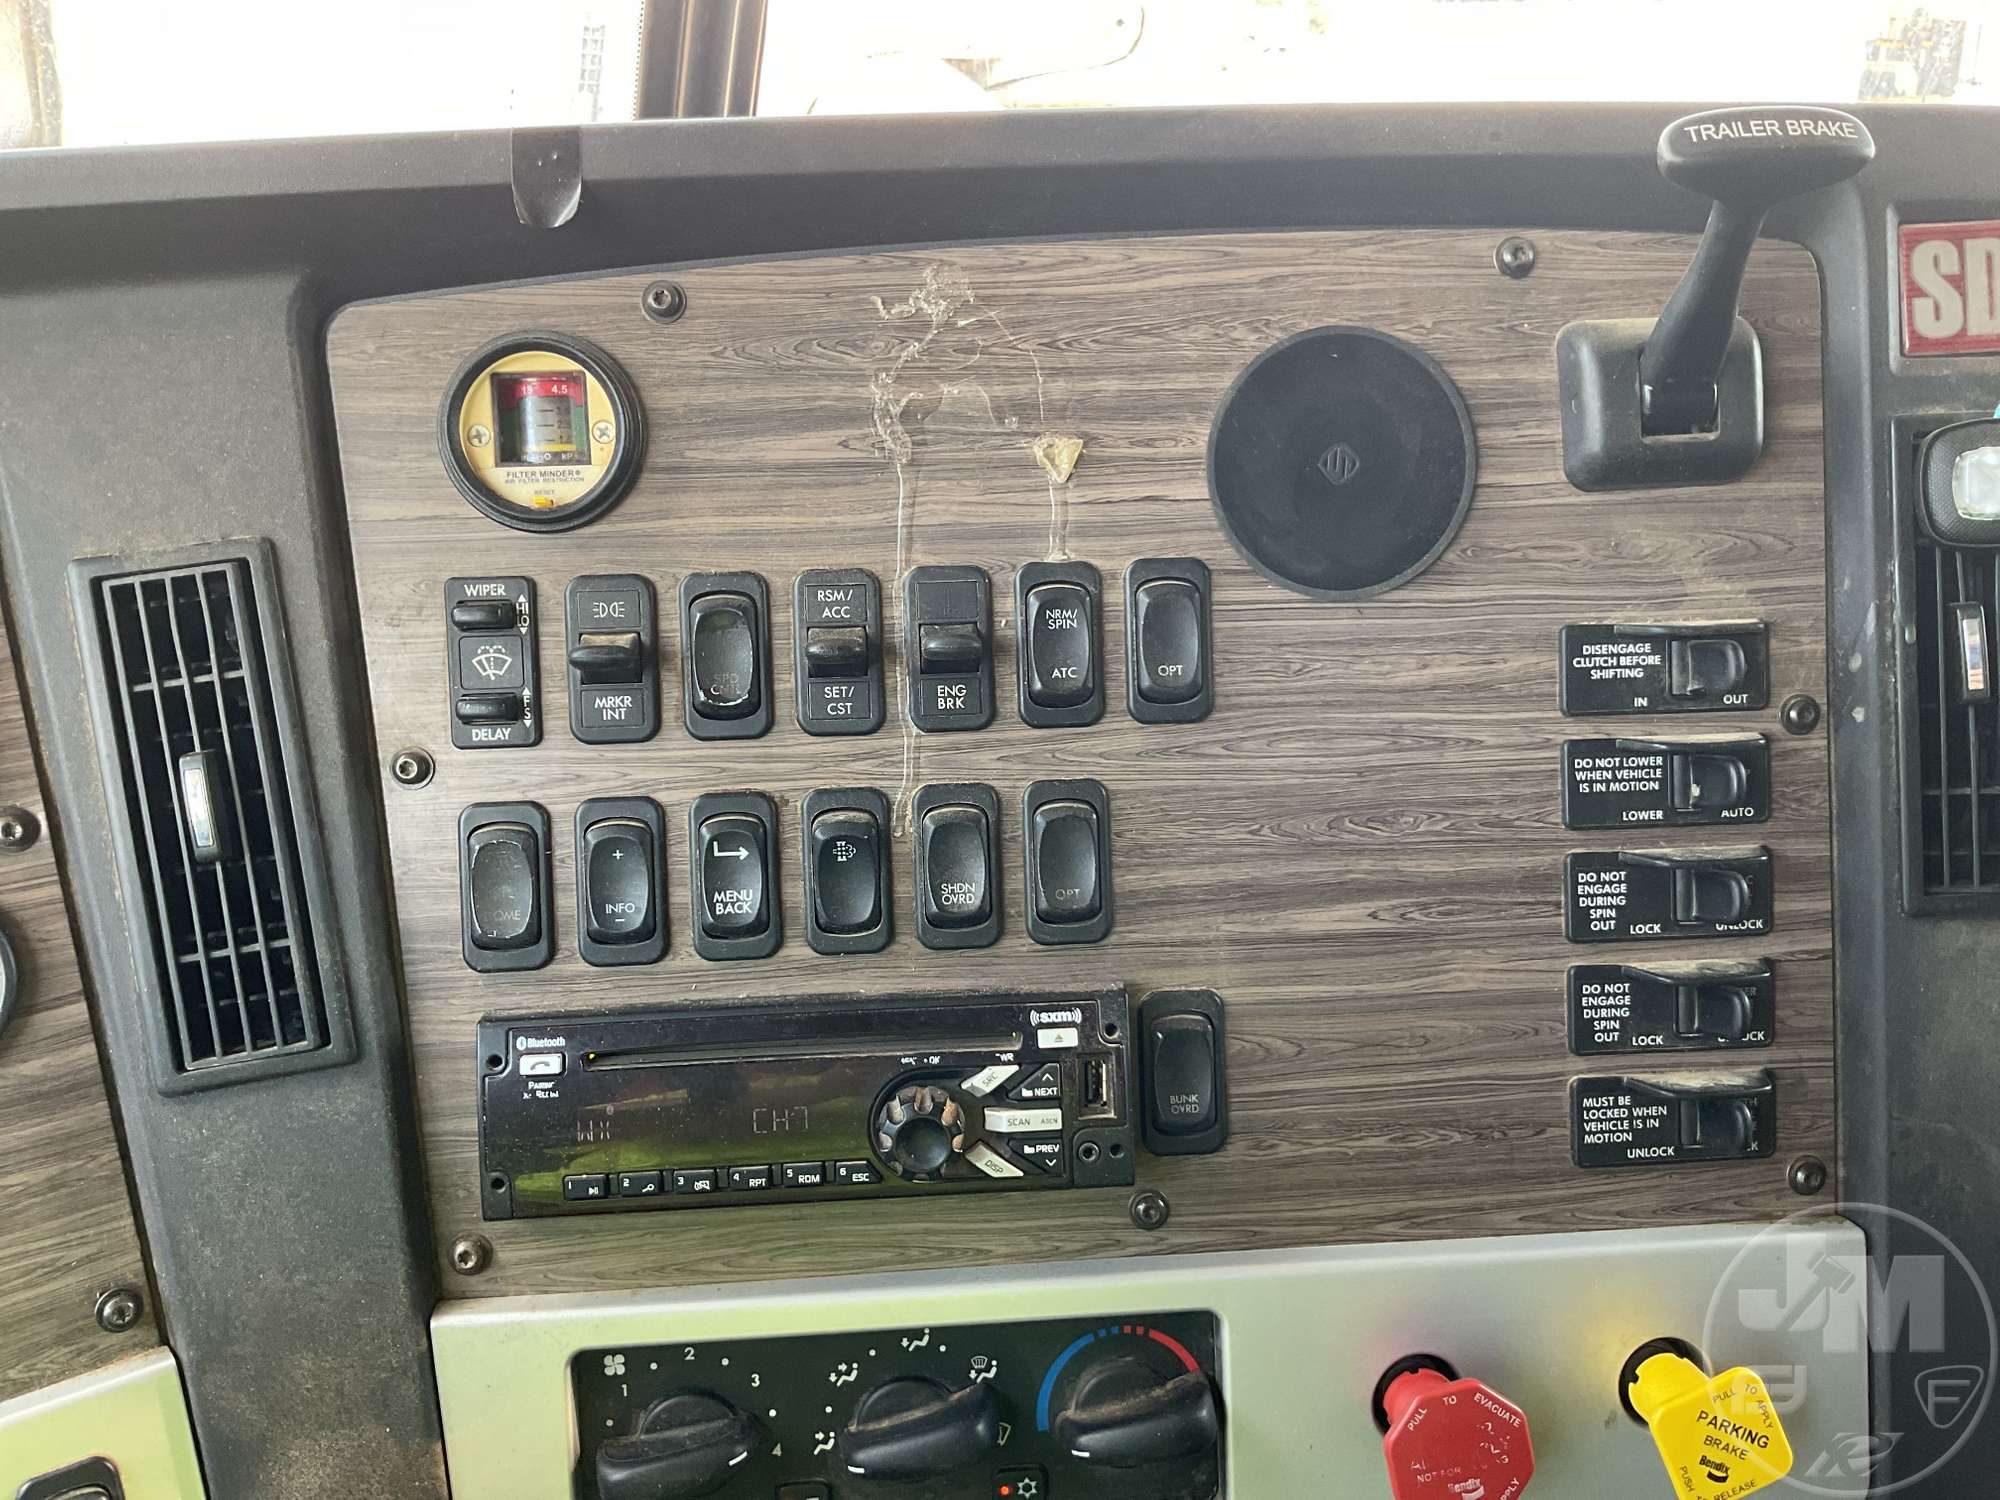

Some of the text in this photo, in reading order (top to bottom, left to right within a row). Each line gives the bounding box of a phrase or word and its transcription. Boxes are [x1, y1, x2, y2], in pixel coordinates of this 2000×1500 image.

[1684, 120, 1858, 142] TRAILER BRAKE
[551, 384, 568, 394] 4.5
[506, 471, 536, 479] FILTER
[464, 584, 506, 596] WIPER
[817, 589, 853, 602] RSM/
[516, 602, 528, 614] HI
[822, 606, 850, 618] ACC
[1046, 608, 1078, 620] NRM/
[516, 615, 530, 626] LO
[1048, 618, 1078, 630] SPIN
[1582, 643, 1652, 655] DISENGAGE
[1572, 656, 1662, 668] CLUTCH BEFORE
[1052, 668, 1078, 679] ATC
[1158, 665, 1183, 676] OPT
[1590, 668, 1644, 680] SHIFTING
[824, 686, 854, 698] SET/
[937, 684, 966, 697] ENG
[524, 695, 530, 706] F
[594, 696, 632, 708] MRKR
[938, 698, 965, 710] BRK
[1634, 697, 1648, 707] IN
[1723, 694, 1748, 704] OUT
[524, 708, 531, 720] S
[602, 708, 626, 720] INT
[827, 702, 852, 714] CST
[472, 728, 511, 742] DELAY
[1574, 756, 1663, 768] DO NOT LOWER
[1575, 768, 1662, 780] WHEN VEHICLE
[1579, 781, 1660, 793] IS IN MOTION
[1622, 810, 1664, 821] LOWER
[1720, 807, 1754, 818] AUTO
[1578, 871, 1626, 883] DO NOT
[940, 882, 976, 894] SHDN
[1055, 888, 1080, 900] OPT
[1577, 884, 1628, 895] ENGAGE
[713, 889, 753, 902] MENU
[941, 893, 975, 905] OVRD
[1579, 896, 1626, 907] DURING
[605, 902, 636, 914] INFO
[715, 902, 752, 915] BACK
[1590, 908, 1616, 919] SPIN
[1590, 920, 1616, 931] OUT
[1630, 924, 1662, 935] LOCK
[1582, 983, 1630, 994] DO NOT
[1582, 996, 1631, 1006] ENGAGE
[1584, 1008, 1630, 1019] DURING
[1593, 1020, 1620, 1030] SPIN
[528, 1036, 566, 1048] Bluetooth
[1594, 1032, 1620, 1042] OUT
[1632, 1035, 1664, 1046] LOCK
[982, 1072, 1000, 1088] SRC
[1034, 1087, 1058, 1096] NEXT
[1170, 1094, 1199, 1104] BUNK
[1582, 1096, 1632, 1108] MUST BE
[1170, 1104, 1200, 1114] OVRD
[1583, 1106, 1668, 1120] LOCKED WHEN
[1008, 1118, 1030, 1127] SCAN
[1584, 1118, 1660, 1132] VEHICLE IS IN
[1584, 1132, 1632, 1144] MOTION
[1036, 1144, 1060, 1153] PREV
[1626, 1146, 1675, 1158] UNLOCK
[984, 1159, 1004, 1174] DISP
[678, 1176, 684, 1184] 3
[733, 1173, 766, 1188] 4 RPT
[786, 1169, 820, 1184] 5 RDM
[840, 1168, 870, 1182] 6 ESC
[568, 1182, 572, 1190] 1
[623, 1178, 630, 1187] 2
[684, 1347, 696, 1360] 2
[750, 1373, 760, 1388] 3
[620, 1383, 628, 1397] 1
[1406, 1406, 1428, 1432] PULL
[1442, 1396, 1457, 1406] TO
[1473, 1392, 1522, 1428] EVACUATE
[1712, 1384, 1774, 1430] PULL TO APPLY
[1696, 1410, 1770, 1450] PARKING
[771, 1442, 782, 1456] 4
[1704, 1434, 1749, 1461] BRAKE
[1698, 1454, 1730, 1475] Bendix
[1680, 1466, 1696, 1492] PUSH
[1448, 1478, 1482, 1493] Bendix
